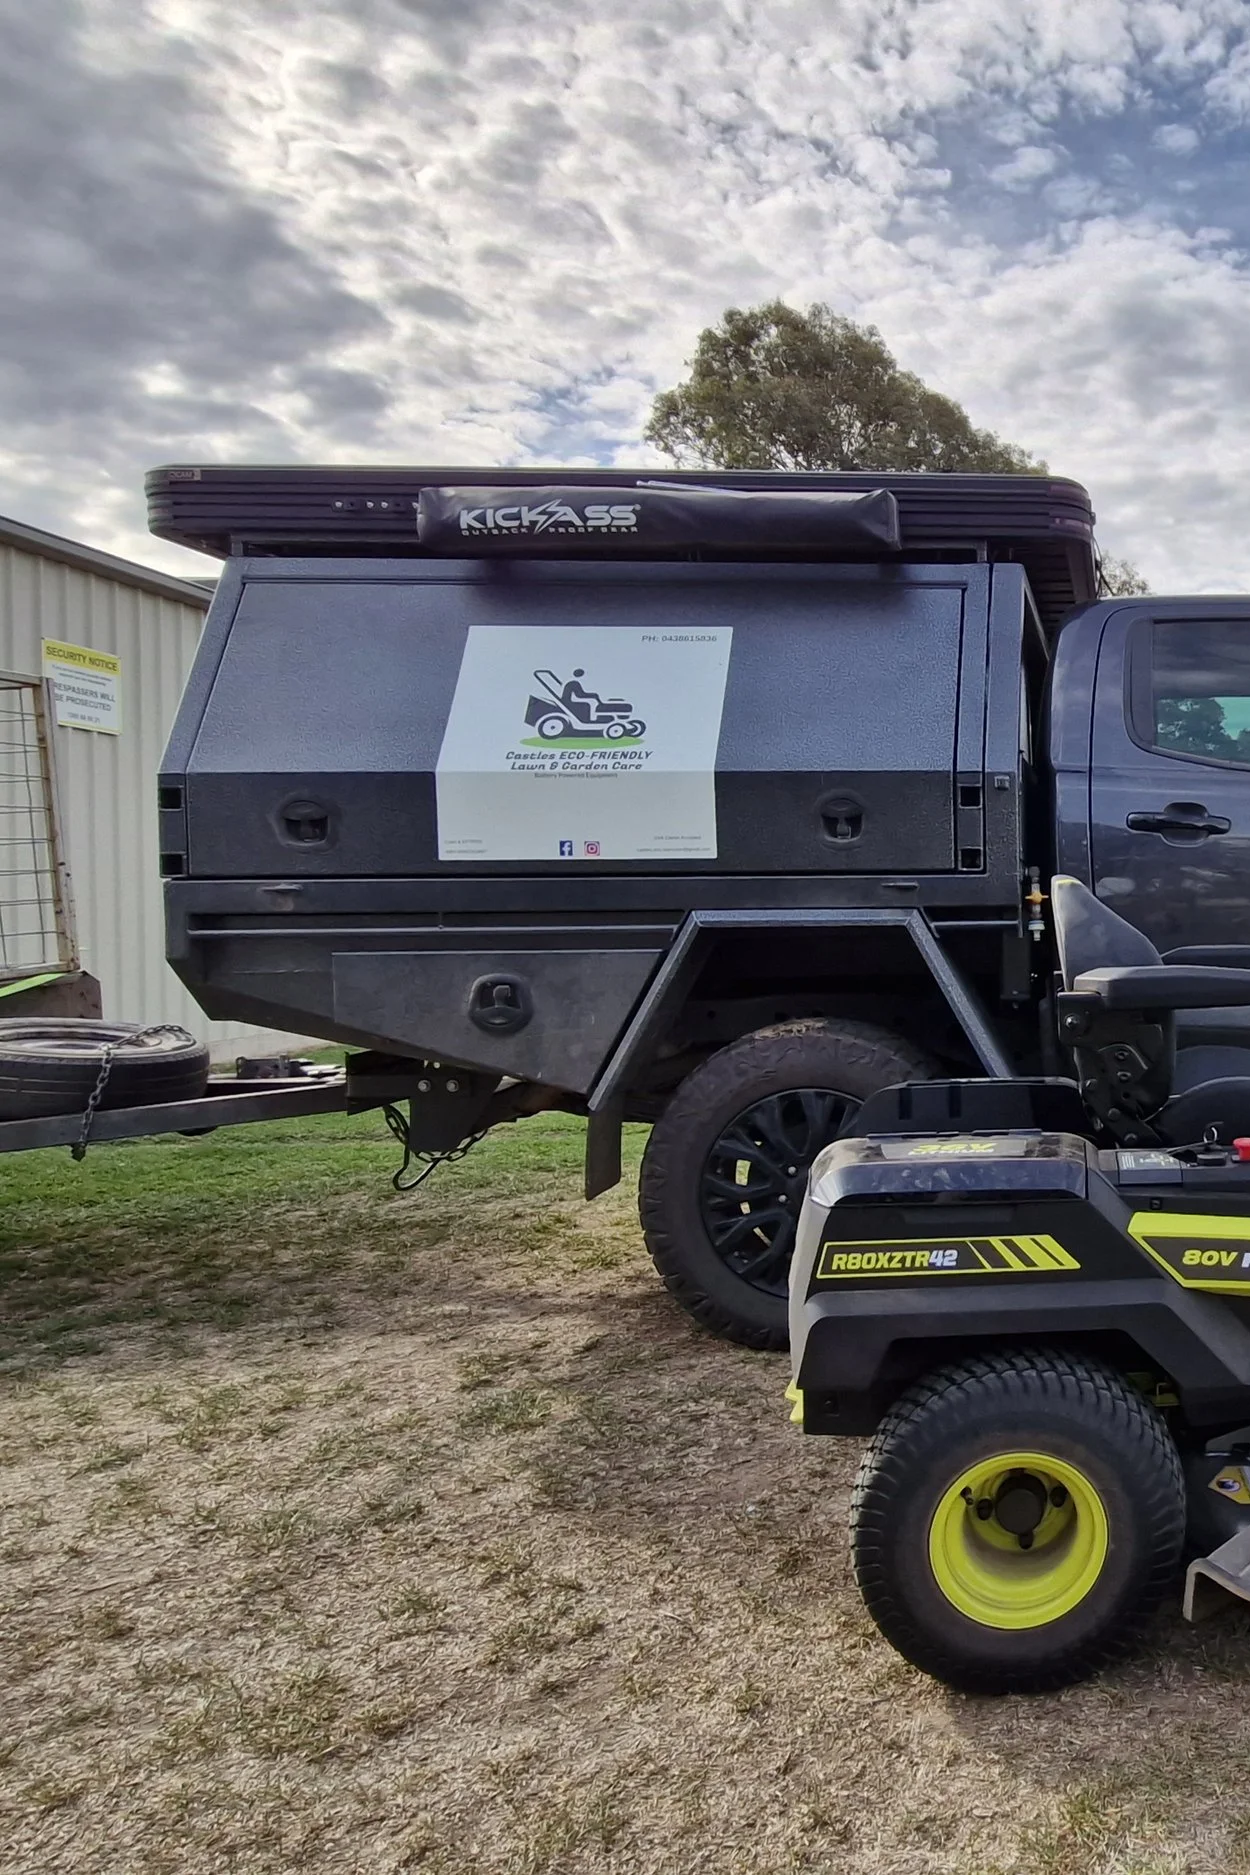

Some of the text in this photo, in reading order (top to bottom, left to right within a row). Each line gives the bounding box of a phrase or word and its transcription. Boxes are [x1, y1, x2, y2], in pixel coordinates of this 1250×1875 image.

[460, 500, 637, 530] KICKASS
[461, 527, 528, 536] OUTBACK
[46, 646, 117, 672] SECURITY NOTICE
[53, 682, 116, 703] RESPASSERS WILL
[66, 696, 112, 712] PROSECUTED
[505, 751, 653, 760] Castles ECO-FRIENDLY
[510, 761, 643, 771] Lawn & Garden Care
[831, 1249, 958, 1270] R80XZTR42
[1182, 1249, 1238, 1266] 80V
